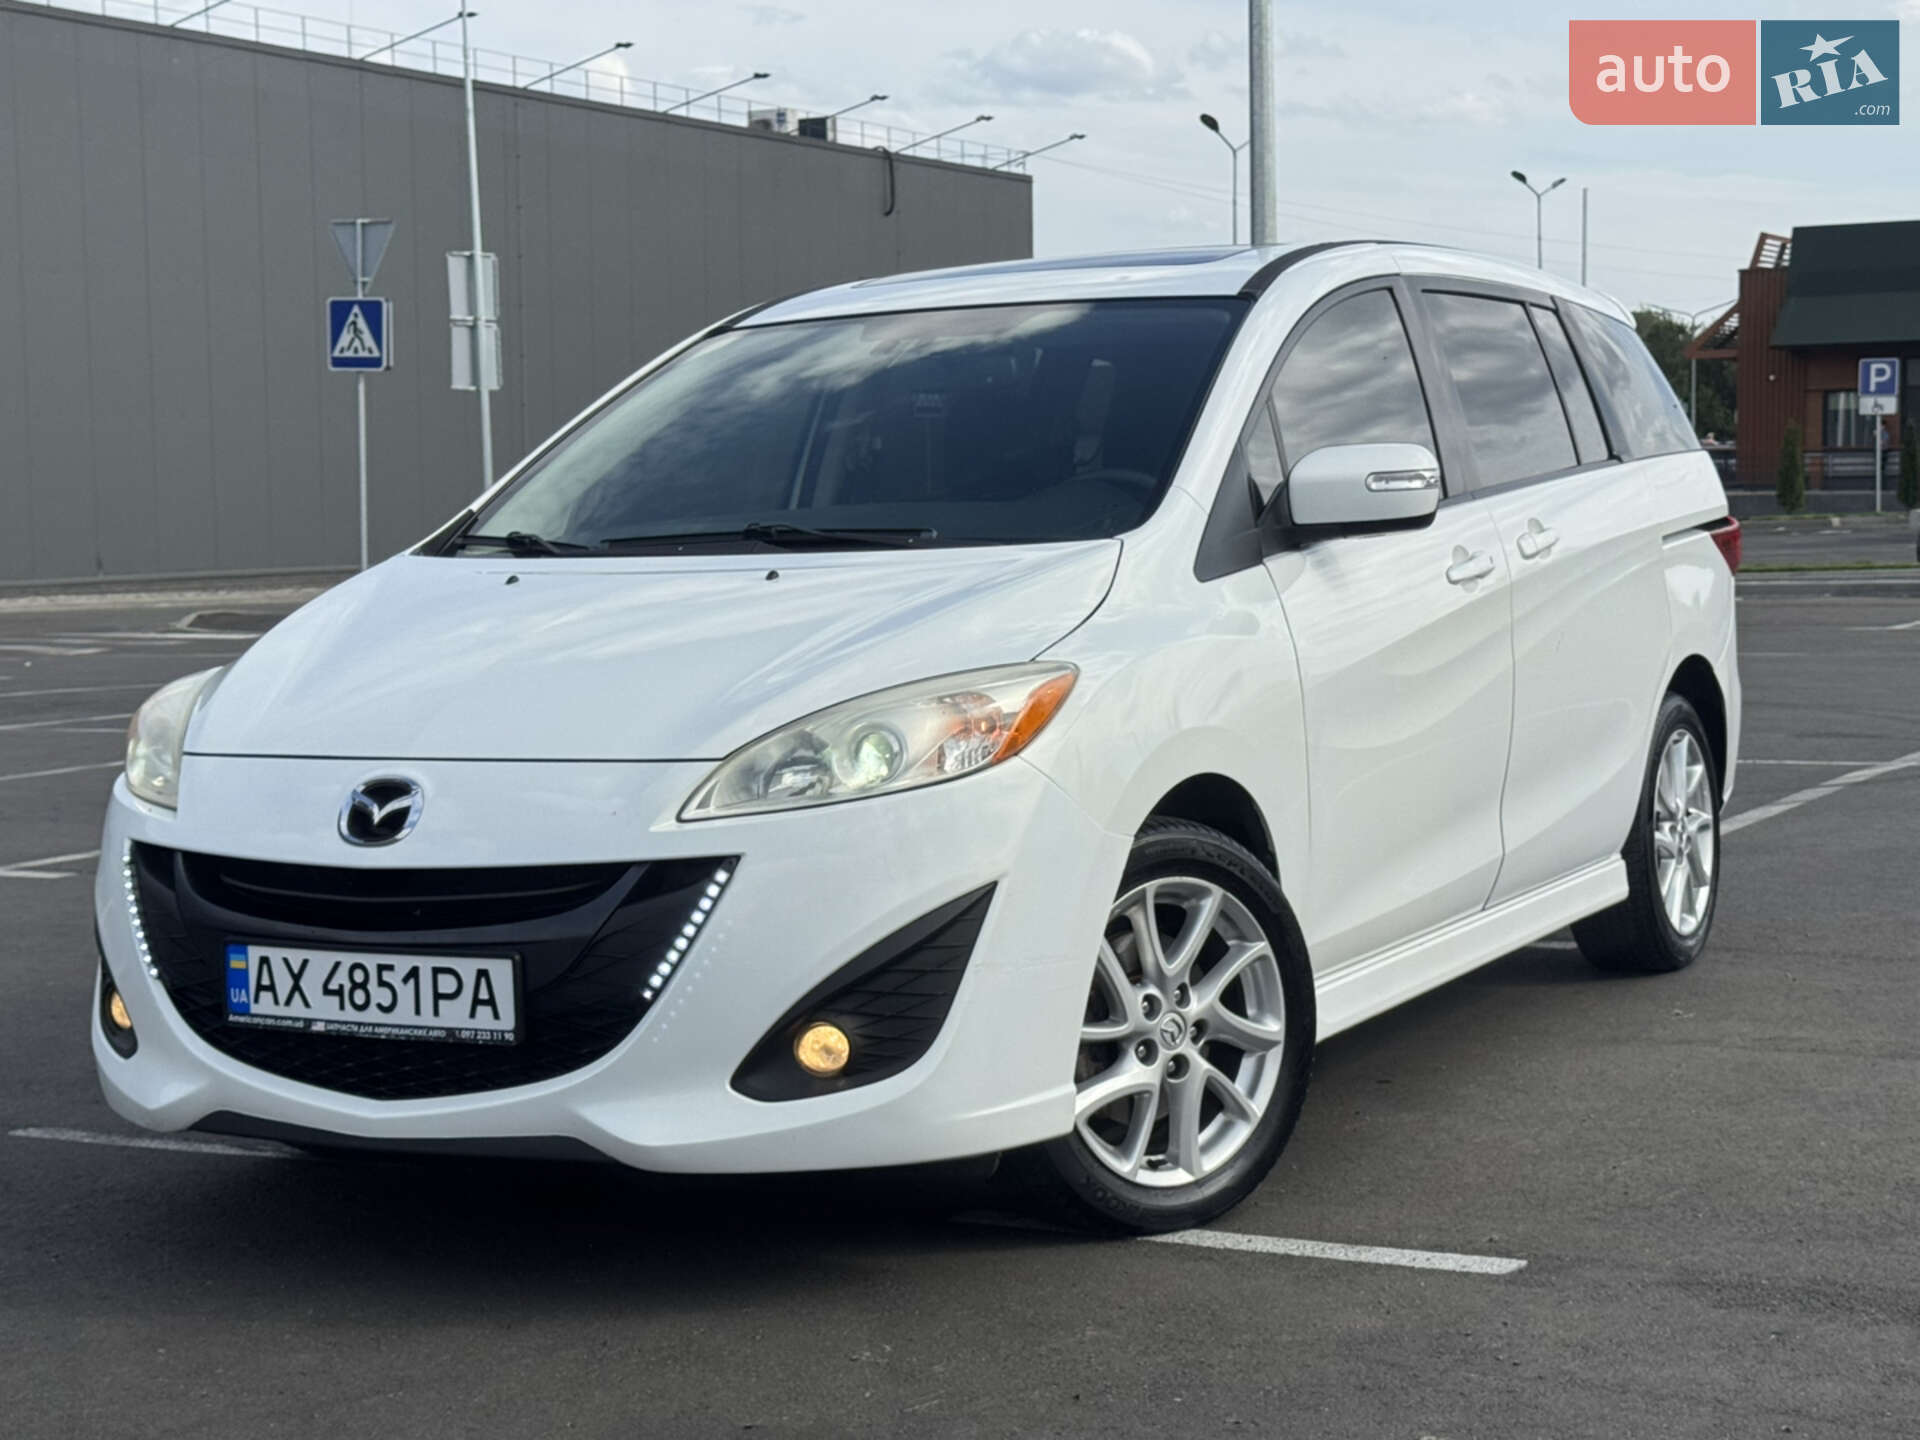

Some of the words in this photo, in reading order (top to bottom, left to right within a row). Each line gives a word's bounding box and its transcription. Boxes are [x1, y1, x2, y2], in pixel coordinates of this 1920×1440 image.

[1869, 362, 1891, 393] P
[230, 987, 249, 1004] UA
[252, 955, 312, 1009] AX
[322, 960, 422, 1016] 4851
